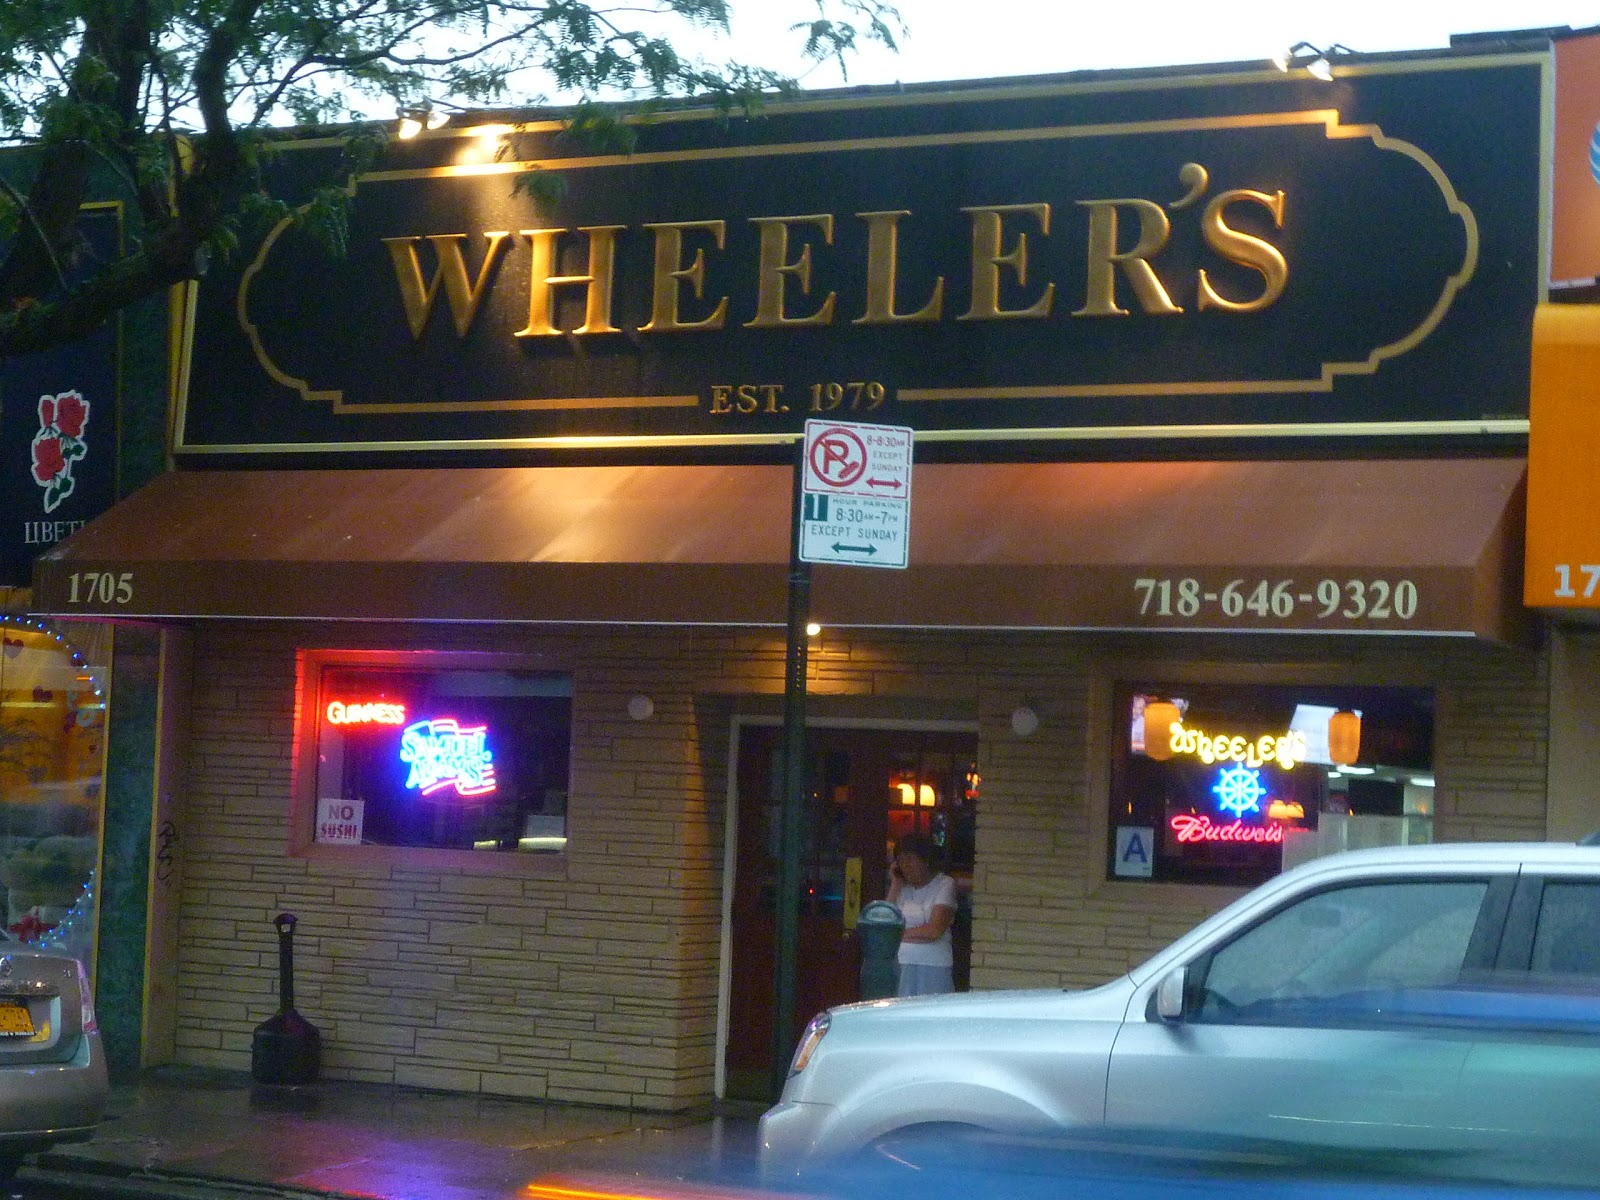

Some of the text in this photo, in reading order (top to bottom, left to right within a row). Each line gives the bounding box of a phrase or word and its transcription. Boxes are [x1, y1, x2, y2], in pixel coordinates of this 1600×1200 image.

[380, 162, 1289, 341] WHEELER'S
[709, 381, 886, 415] EST. 1979
[870, 461, 903, 473] SUNDAY
[872, 450, 903, 461] EXCEPT
[832, 497, 903, 510] HOUR PARKING
[24, 520, 86, 544] ЦВЕТ
[811, 524, 898, 542] EXCEPT SUNDAY
[67, 572, 134, 604] 1705
[1133, 577, 1418, 620] 718-646-9320
[326, 701, 406, 725] GUINNESS
[327, 805, 355, 821] NO
[320, 823, 357, 839] SUSHI
[1122, 832, 1148, 864] A
